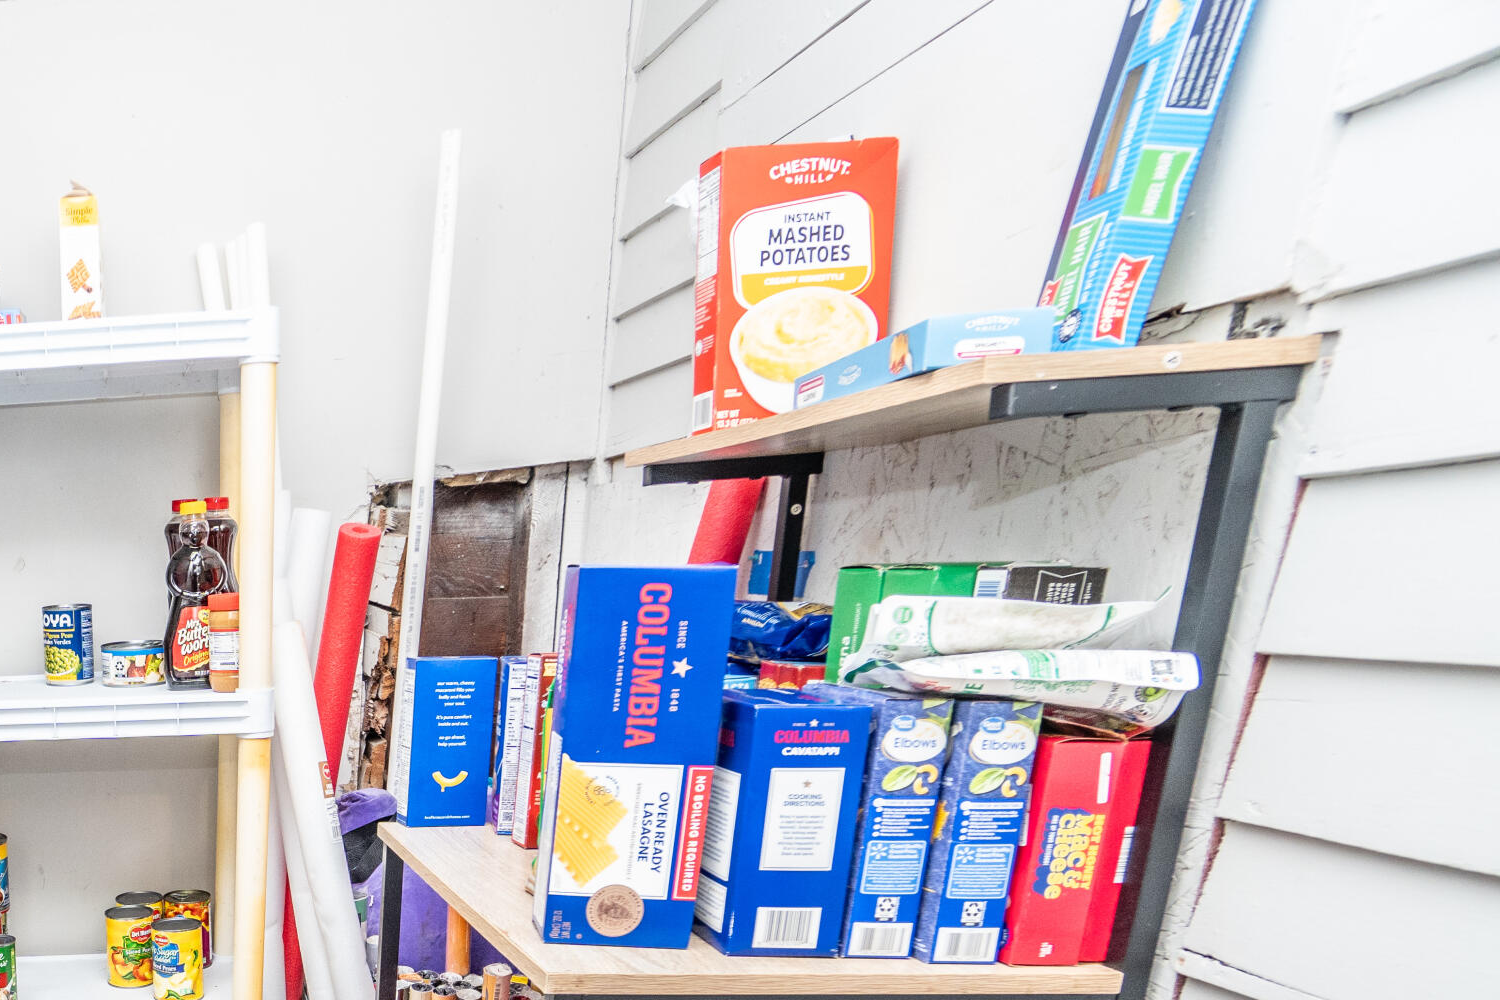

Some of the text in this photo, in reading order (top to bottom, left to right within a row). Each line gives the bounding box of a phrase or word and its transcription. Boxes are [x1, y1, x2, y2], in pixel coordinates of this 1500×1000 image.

[794, 174, 824, 184] HILL
[784, 211, 831, 223] INSTANT
[768, 224, 844, 246] MASHED
[1073, 223, 1095, 266] HAIR
[760, 244, 850, 266] POTATOES
[178, 626, 209, 645] Butte
[676, 620, 688, 649] SINCE
[612, 620, 629, 712] AMERICA'S FIRST PASTA
[624, 582, 672, 748] COLUMBIA
[774, 730, 850, 743] COLUMBIA
[894, 738, 937, 749] Elbows
[981, 740, 1026, 751] Elbows
[638, 802, 655, 862] LASAGNE
[650, 792, 670, 874] OVEN READY
[681, 776, 707, 892] NO BOILING REQUIRED
